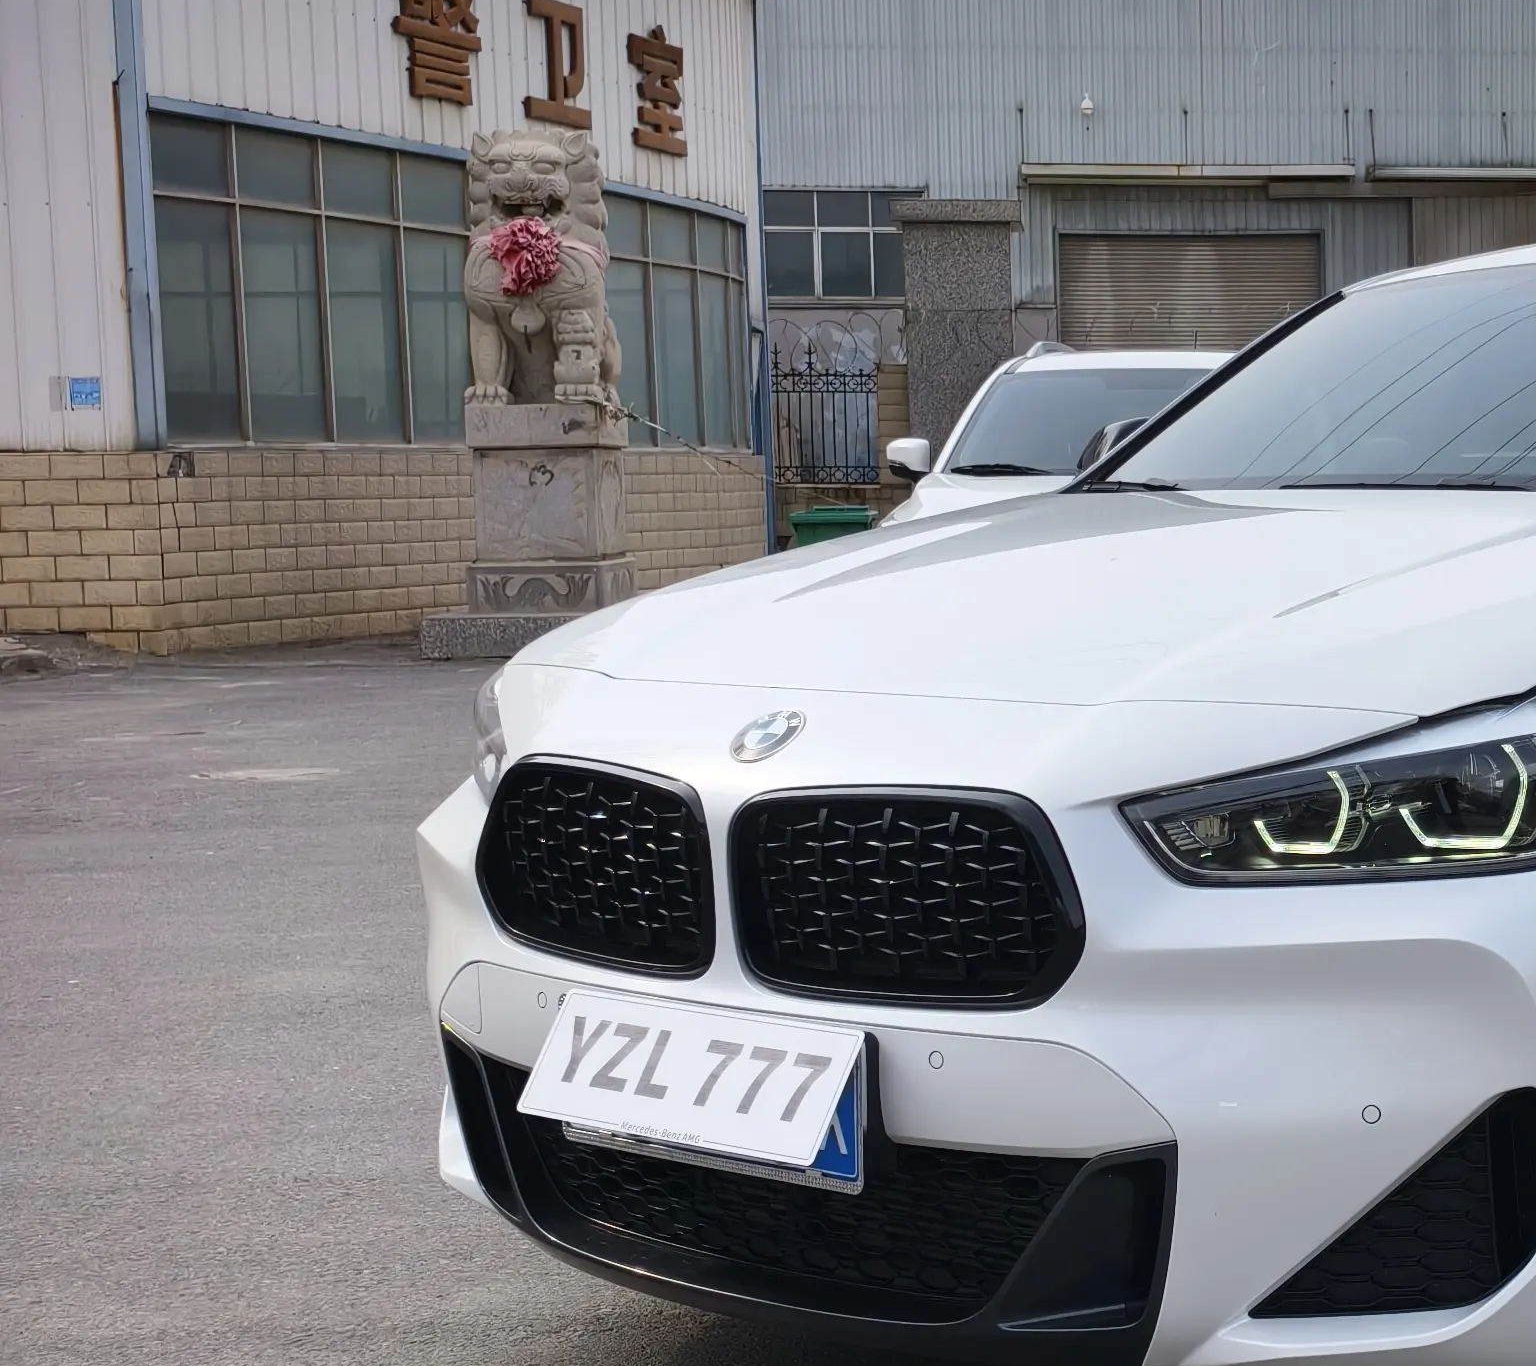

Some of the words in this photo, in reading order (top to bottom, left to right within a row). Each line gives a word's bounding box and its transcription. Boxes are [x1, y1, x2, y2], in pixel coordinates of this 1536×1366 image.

[561, 1016, 671, 1099] YZL
[693, 1039, 832, 1122] 777
[620, 1121, 682, 1140] Mercedes-Benz
[681, 1133, 701, 1144] AMG
